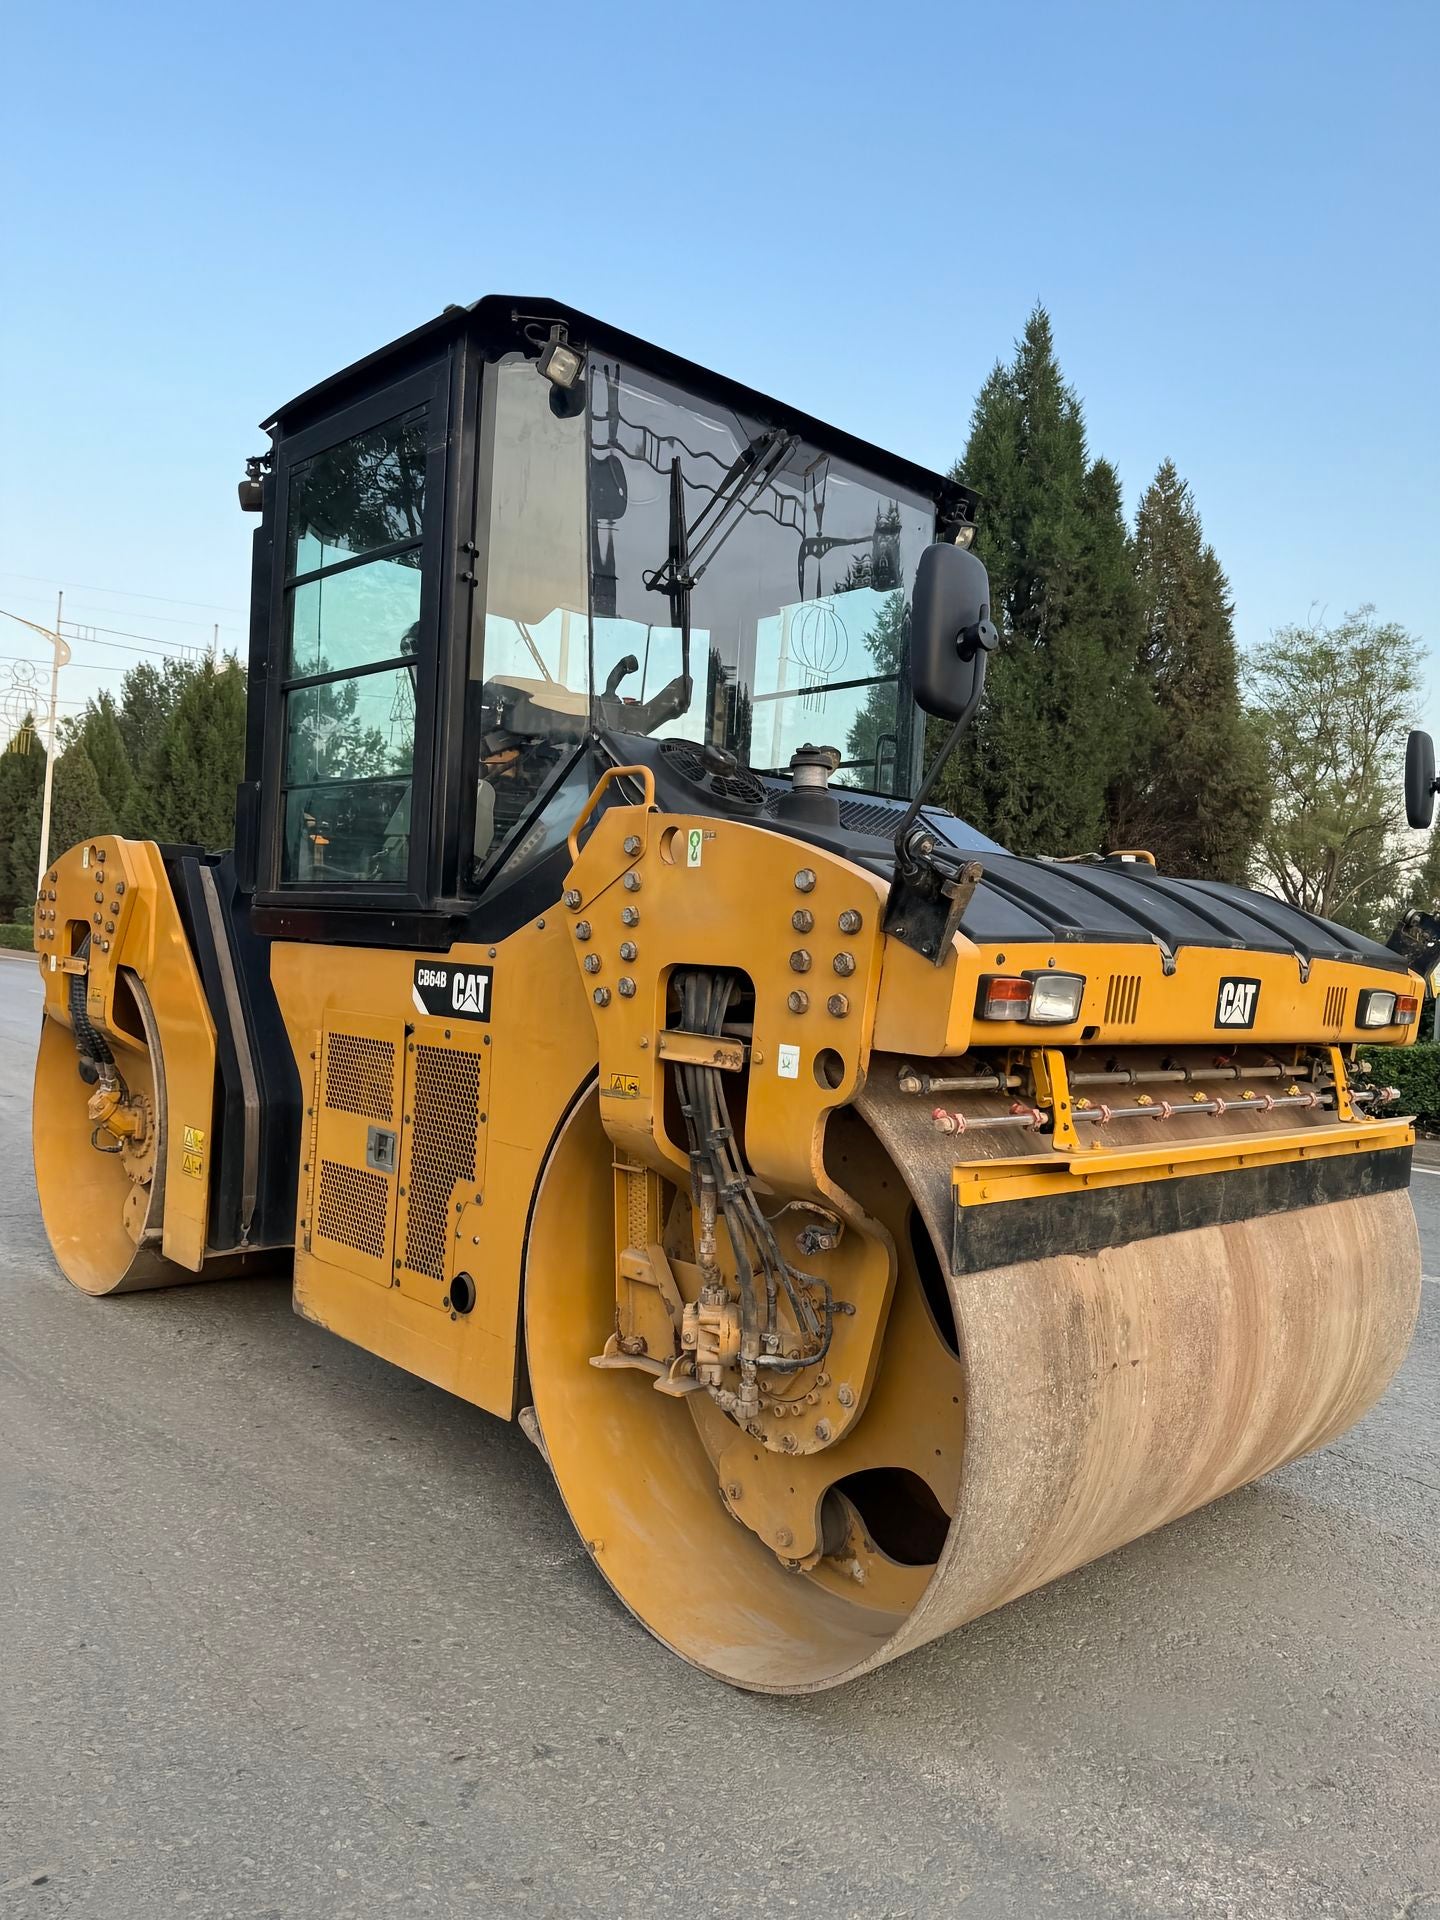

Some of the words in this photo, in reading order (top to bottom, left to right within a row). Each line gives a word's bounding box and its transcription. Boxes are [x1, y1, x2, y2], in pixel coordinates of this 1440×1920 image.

[418, 968, 447, 988] CB64B
[452, 972, 489, 1013] CAT
[1219, 982, 1257, 1024] CAT
